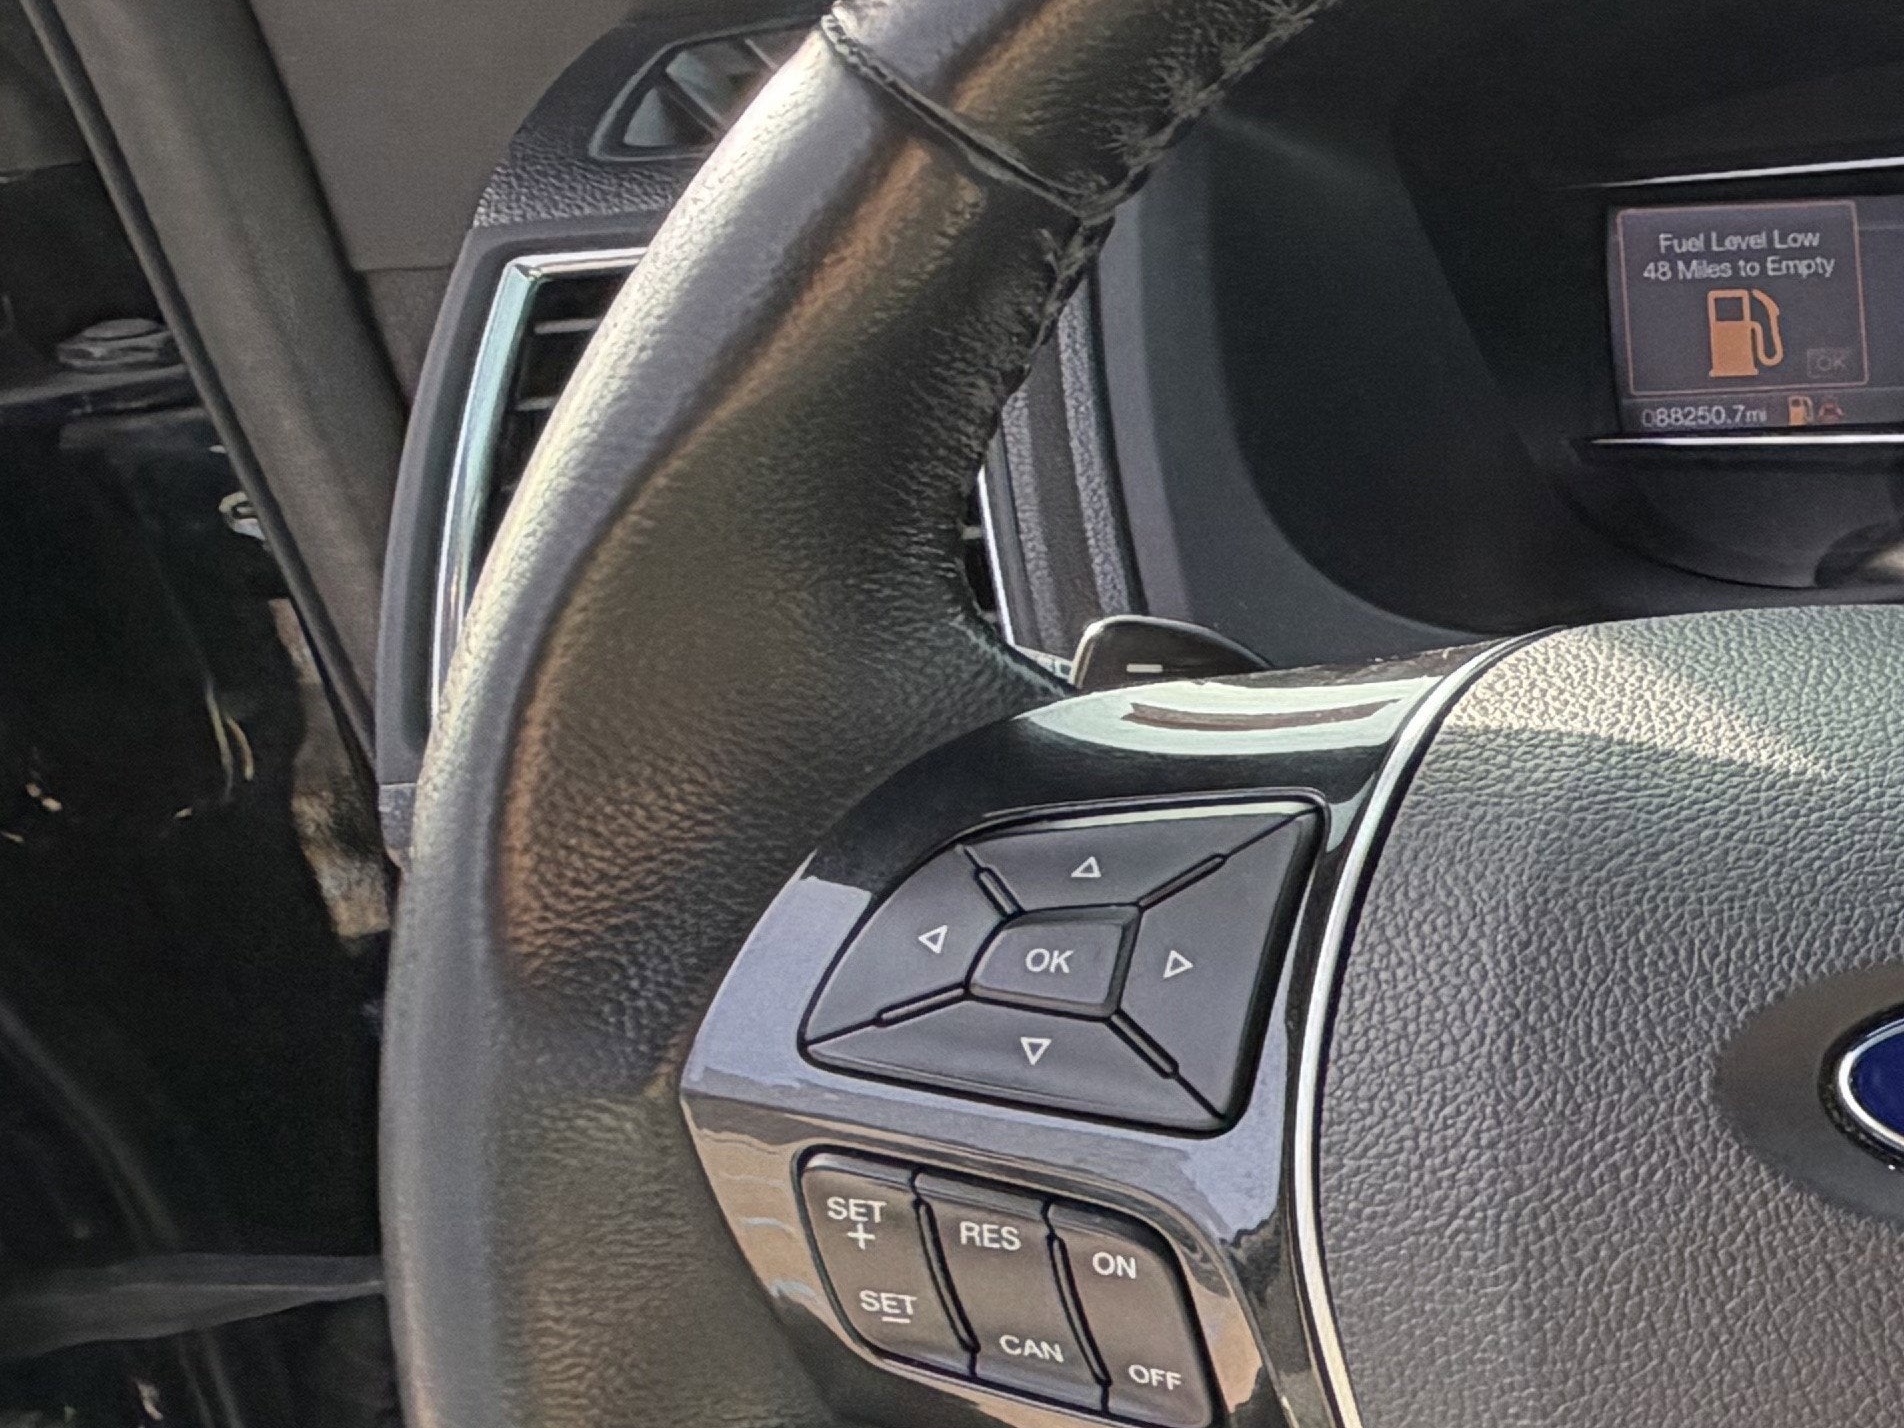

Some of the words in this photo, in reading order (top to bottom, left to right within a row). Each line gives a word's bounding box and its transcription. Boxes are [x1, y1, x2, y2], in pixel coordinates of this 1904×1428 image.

[1659, 232, 1705, 253] Fuel
[1710, 231, 1768, 251] Level
[1773, 229, 1820, 248] Low
[1643, 262, 1672, 281] 48
[1677, 259, 1733, 280] Miles
[1739, 259, 1760, 276] to
[1767, 256, 1836, 280] Empty
[1025, 947, 1074, 974] OK
[827, 1198, 887, 1224] SET
[959, 1221, 1021, 1251] RES
[1092, 1252, 1137, 1280] ON
[860, 1290, 917, 1316] SET
[999, 1335, 1064, 1364] CAN
[1128, 1364, 1182, 1391] OFF
